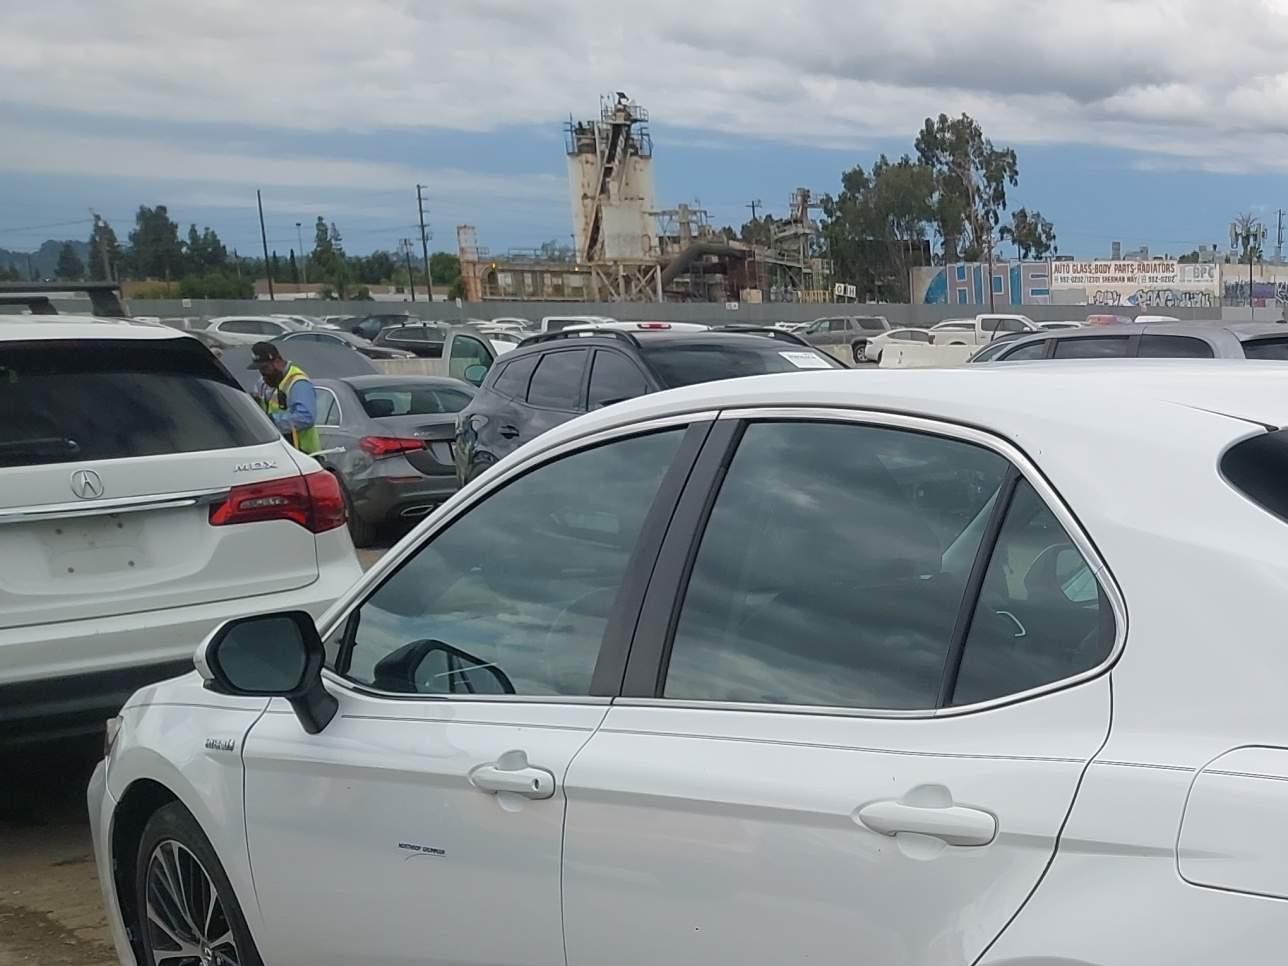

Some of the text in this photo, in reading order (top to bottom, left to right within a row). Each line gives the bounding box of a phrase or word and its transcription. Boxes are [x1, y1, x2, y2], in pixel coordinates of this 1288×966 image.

[1054, 263, 1175, 274] AUTO GLASS BODY PARTS RADIATORS
